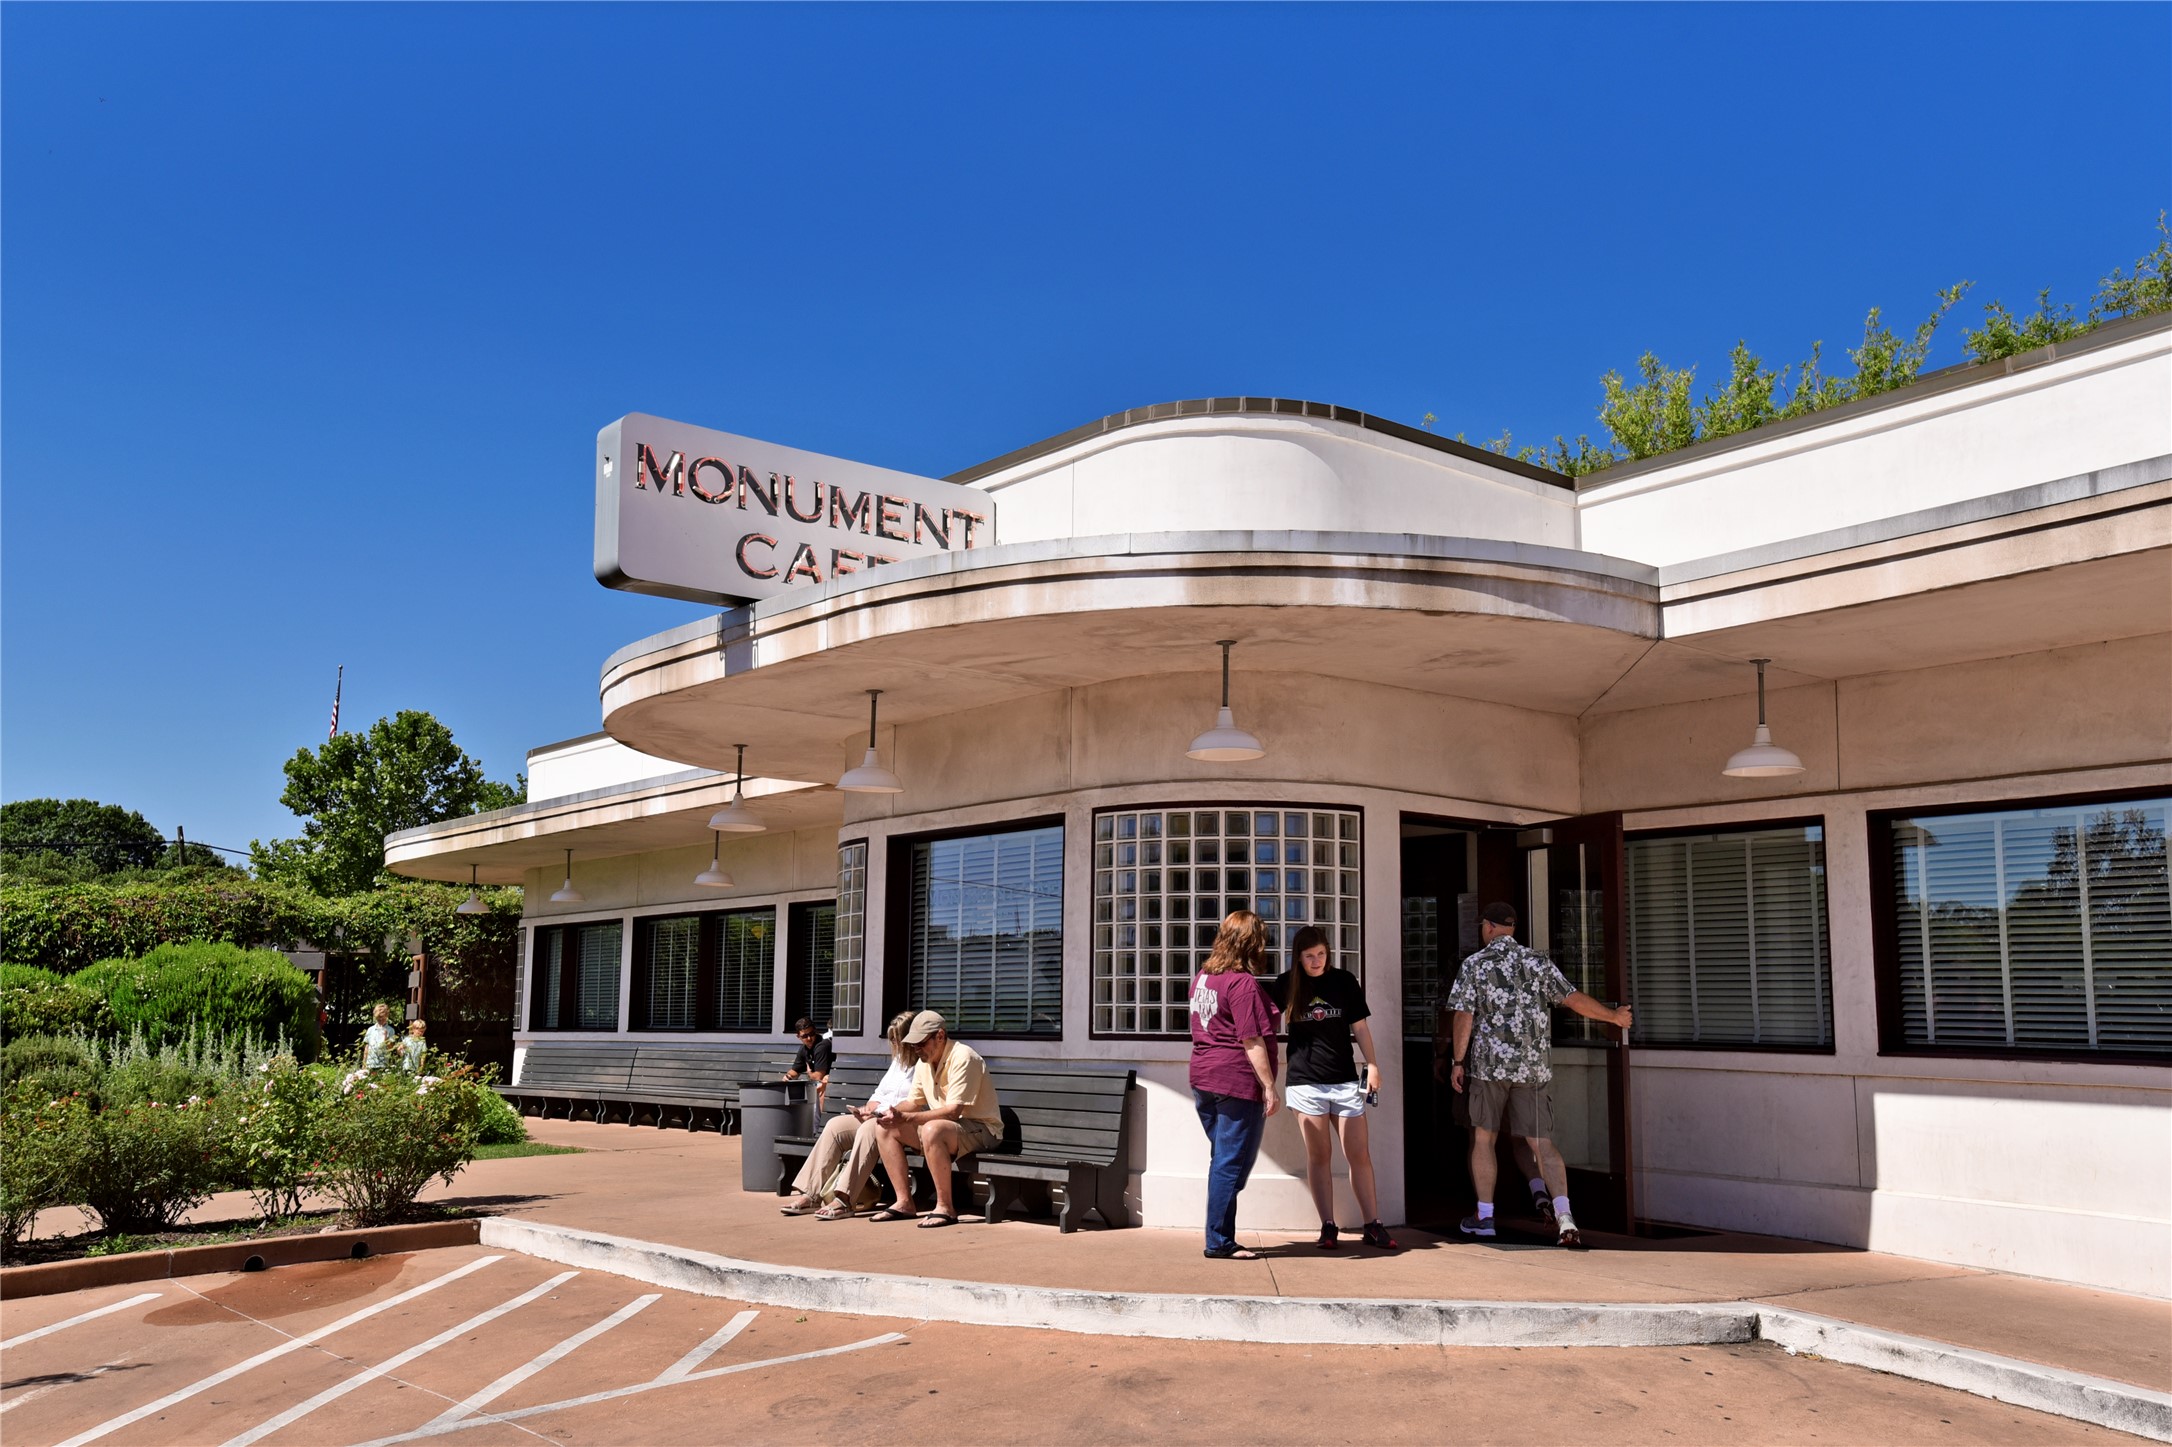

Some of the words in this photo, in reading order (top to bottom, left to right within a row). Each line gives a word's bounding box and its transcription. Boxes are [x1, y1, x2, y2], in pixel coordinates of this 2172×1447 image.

[635, 442, 986, 550] MONUMENT
[736, 532, 899, 584] CAF
[1195, 987, 1217, 1004] TEXAS
